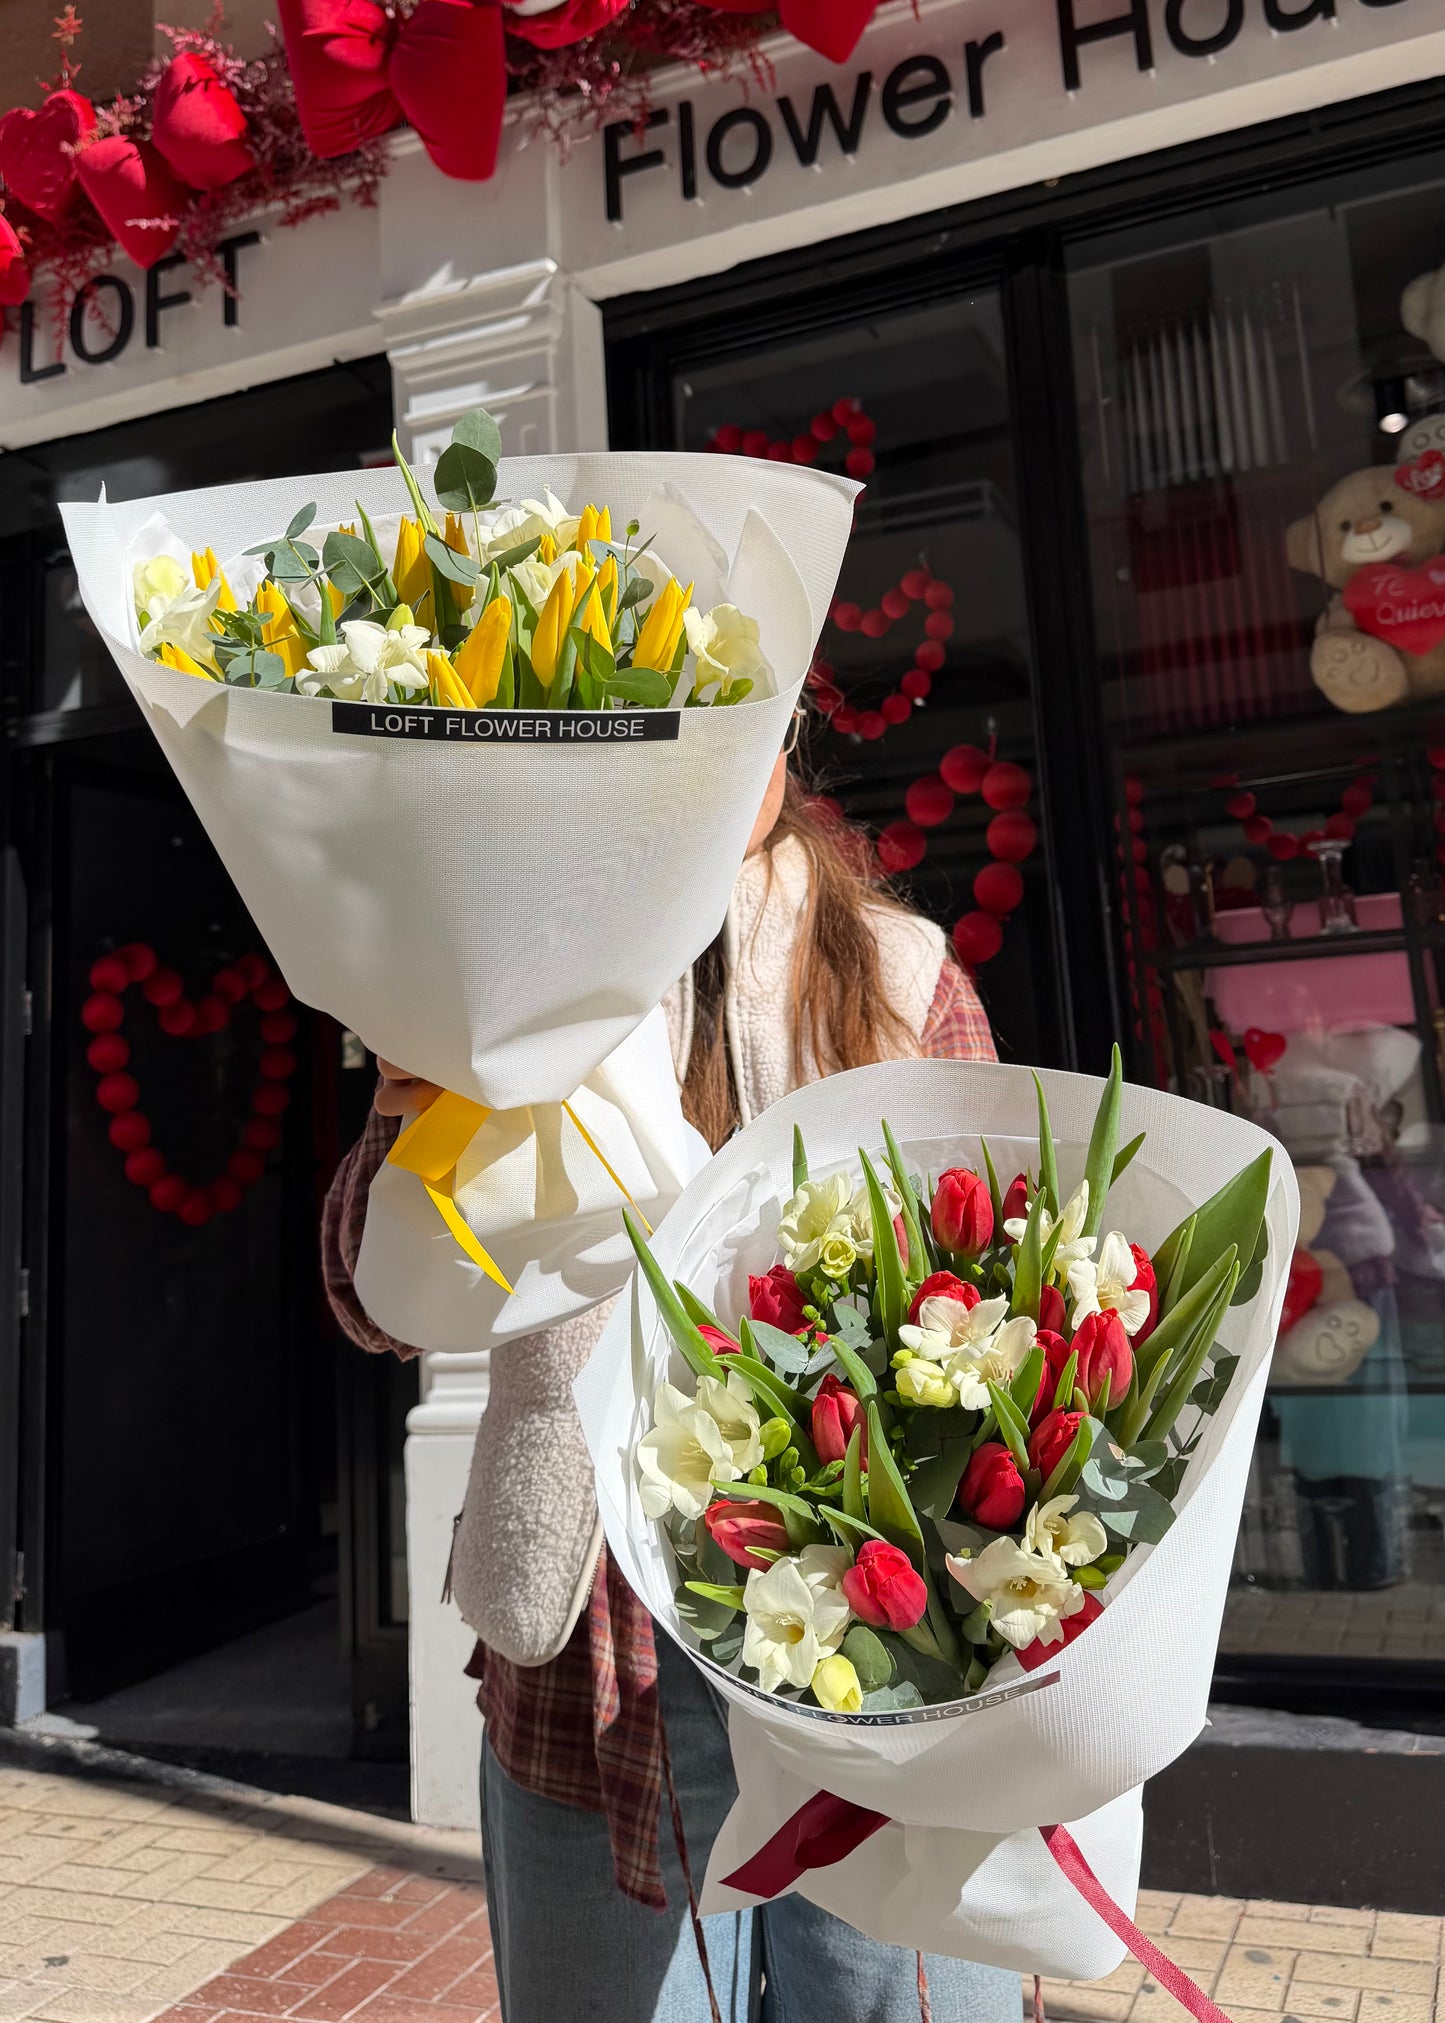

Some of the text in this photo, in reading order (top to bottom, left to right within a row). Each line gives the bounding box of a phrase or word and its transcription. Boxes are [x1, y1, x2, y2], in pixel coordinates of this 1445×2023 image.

[20, 0, 1406, 384] LOFT Flower Ho
[371, 712, 645, 738] LOFT FLOWER HOUSE
[795, 1706, 914, 1725] FLOWER
[922, 1687, 1021, 1720] HOUSE
